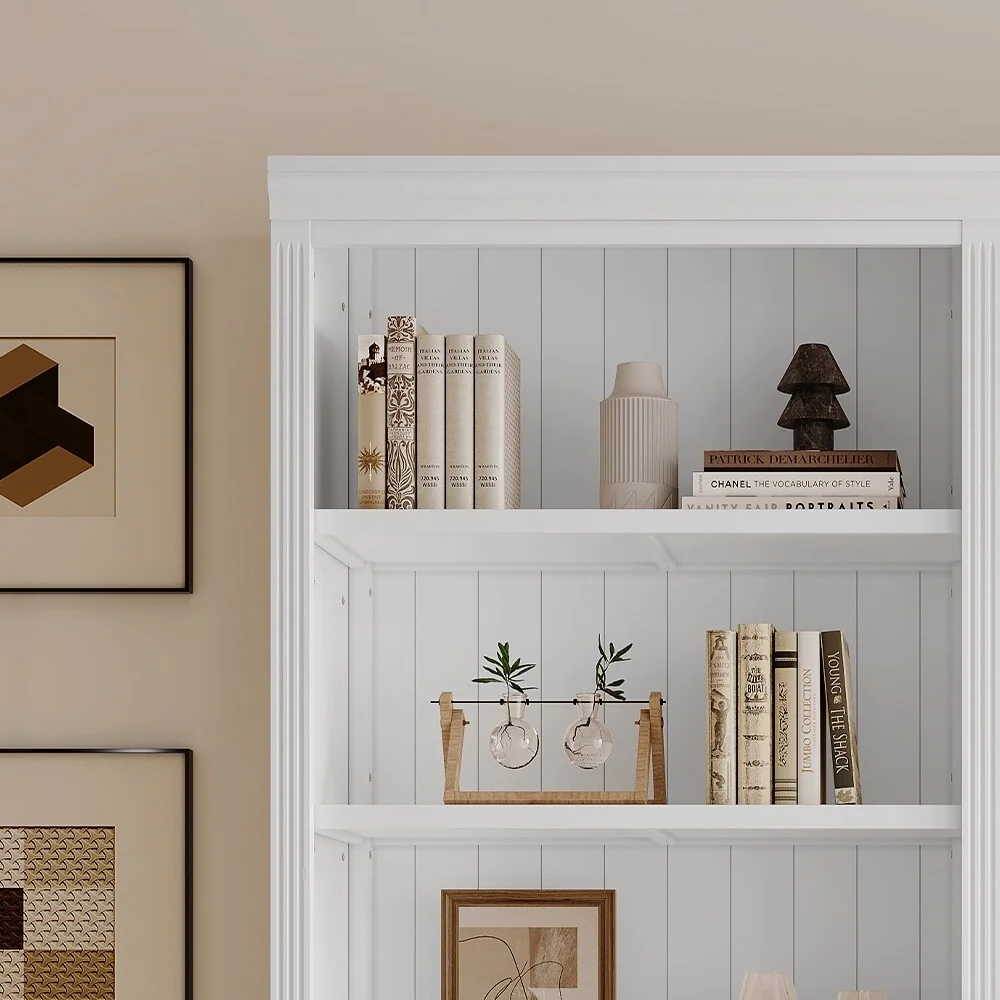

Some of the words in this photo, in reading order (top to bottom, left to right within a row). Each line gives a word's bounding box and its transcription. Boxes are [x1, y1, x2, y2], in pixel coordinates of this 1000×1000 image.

[709, 455, 763, 465] PATRICK
[770, 455, 874, 465] DEMARCHELIER
[711, 480, 751, 488] CHANEL
[754, 480, 770, 488] THE
[772, 480, 829, 488] VOCABULARY
[832, 480, 843, 488] OF
[846, 480, 871, 488] STYLE
[828, 651, 842, 695] YOUNG
[802, 669, 811, 734] COLLECTION
[831, 706, 845, 732] THE
[802, 738, 814, 774] JUMBO
[833, 736, 850, 774] SHACK
